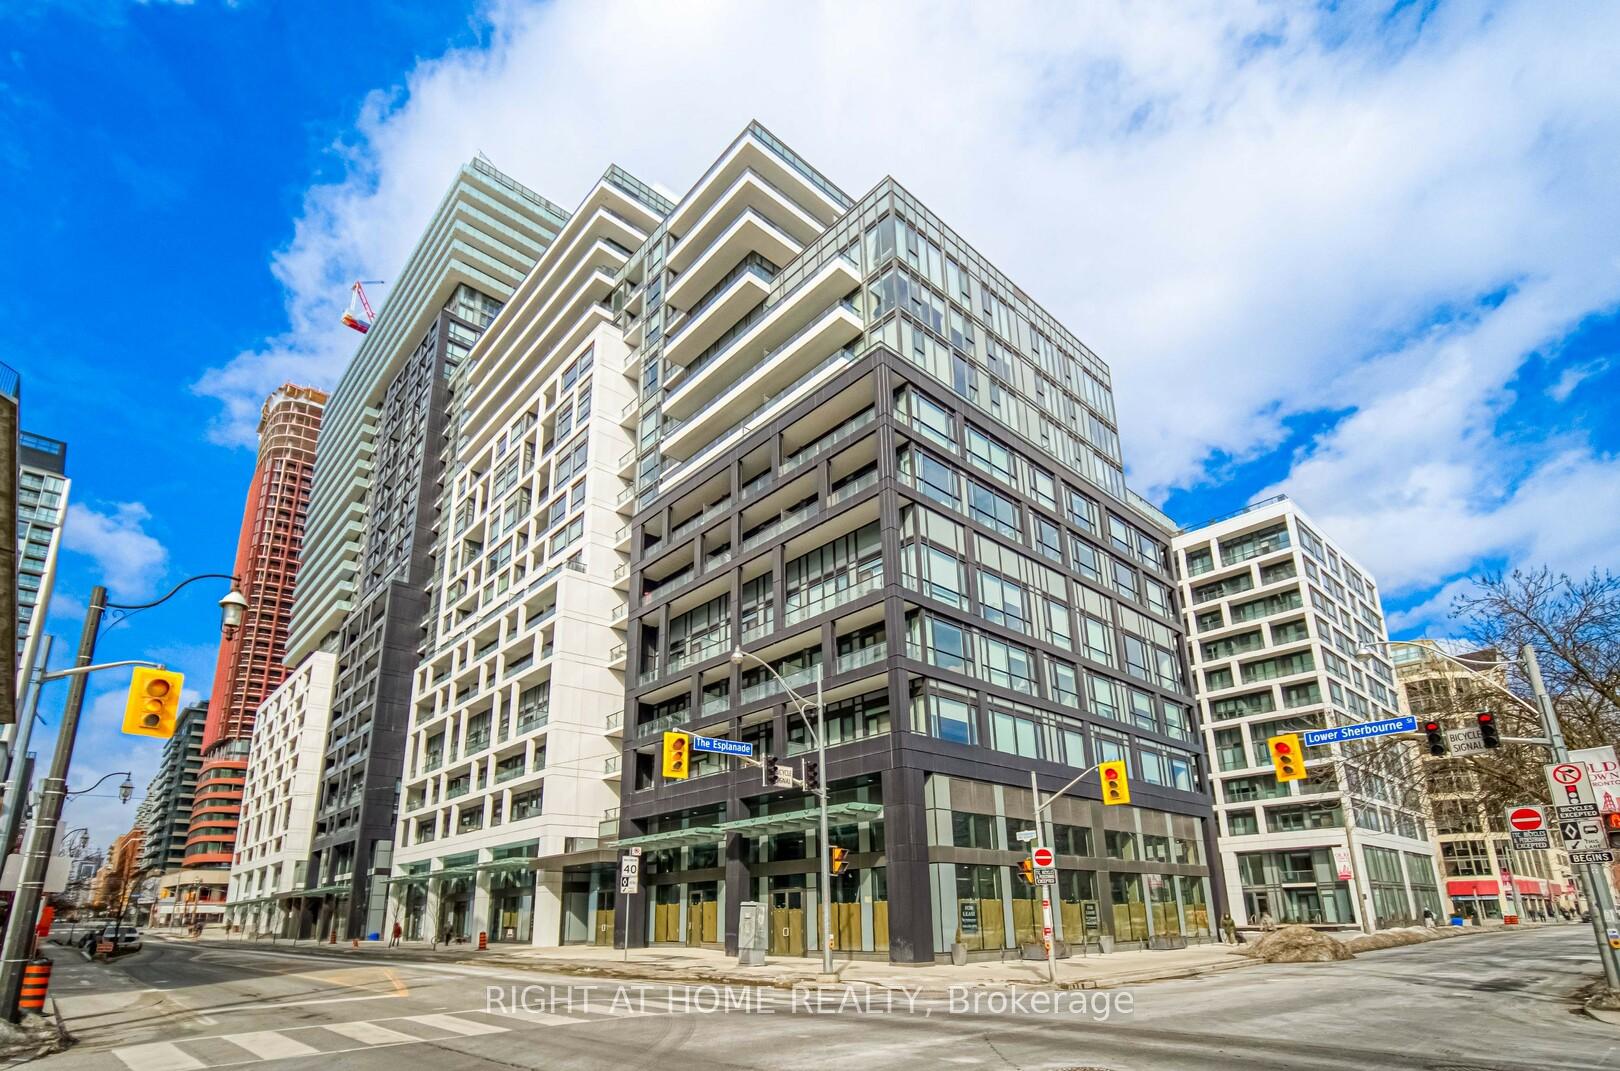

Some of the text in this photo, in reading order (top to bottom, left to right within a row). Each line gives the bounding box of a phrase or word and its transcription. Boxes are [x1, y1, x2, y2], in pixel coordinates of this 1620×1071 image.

[1308, 730, 1338, 744] Lower
[1341, 721, 1403, 738] Sherbourne
[1450, 730, 1482, 743] BICYCLE
[697, 738, 751, 753] The Esplanade
[1453, 741, 1483, 753] SIGNAL
[1586, 761, 1617, 773] LD
[1589, 771, 1619, 782] OWN
[1560, 804, 1595, 813] BICYCLES
[1560, 810, 1598, 819] EXCEPTED
[1572, 853, 1609, 863] BEGINS
[623, 864, 637, 874] 40
